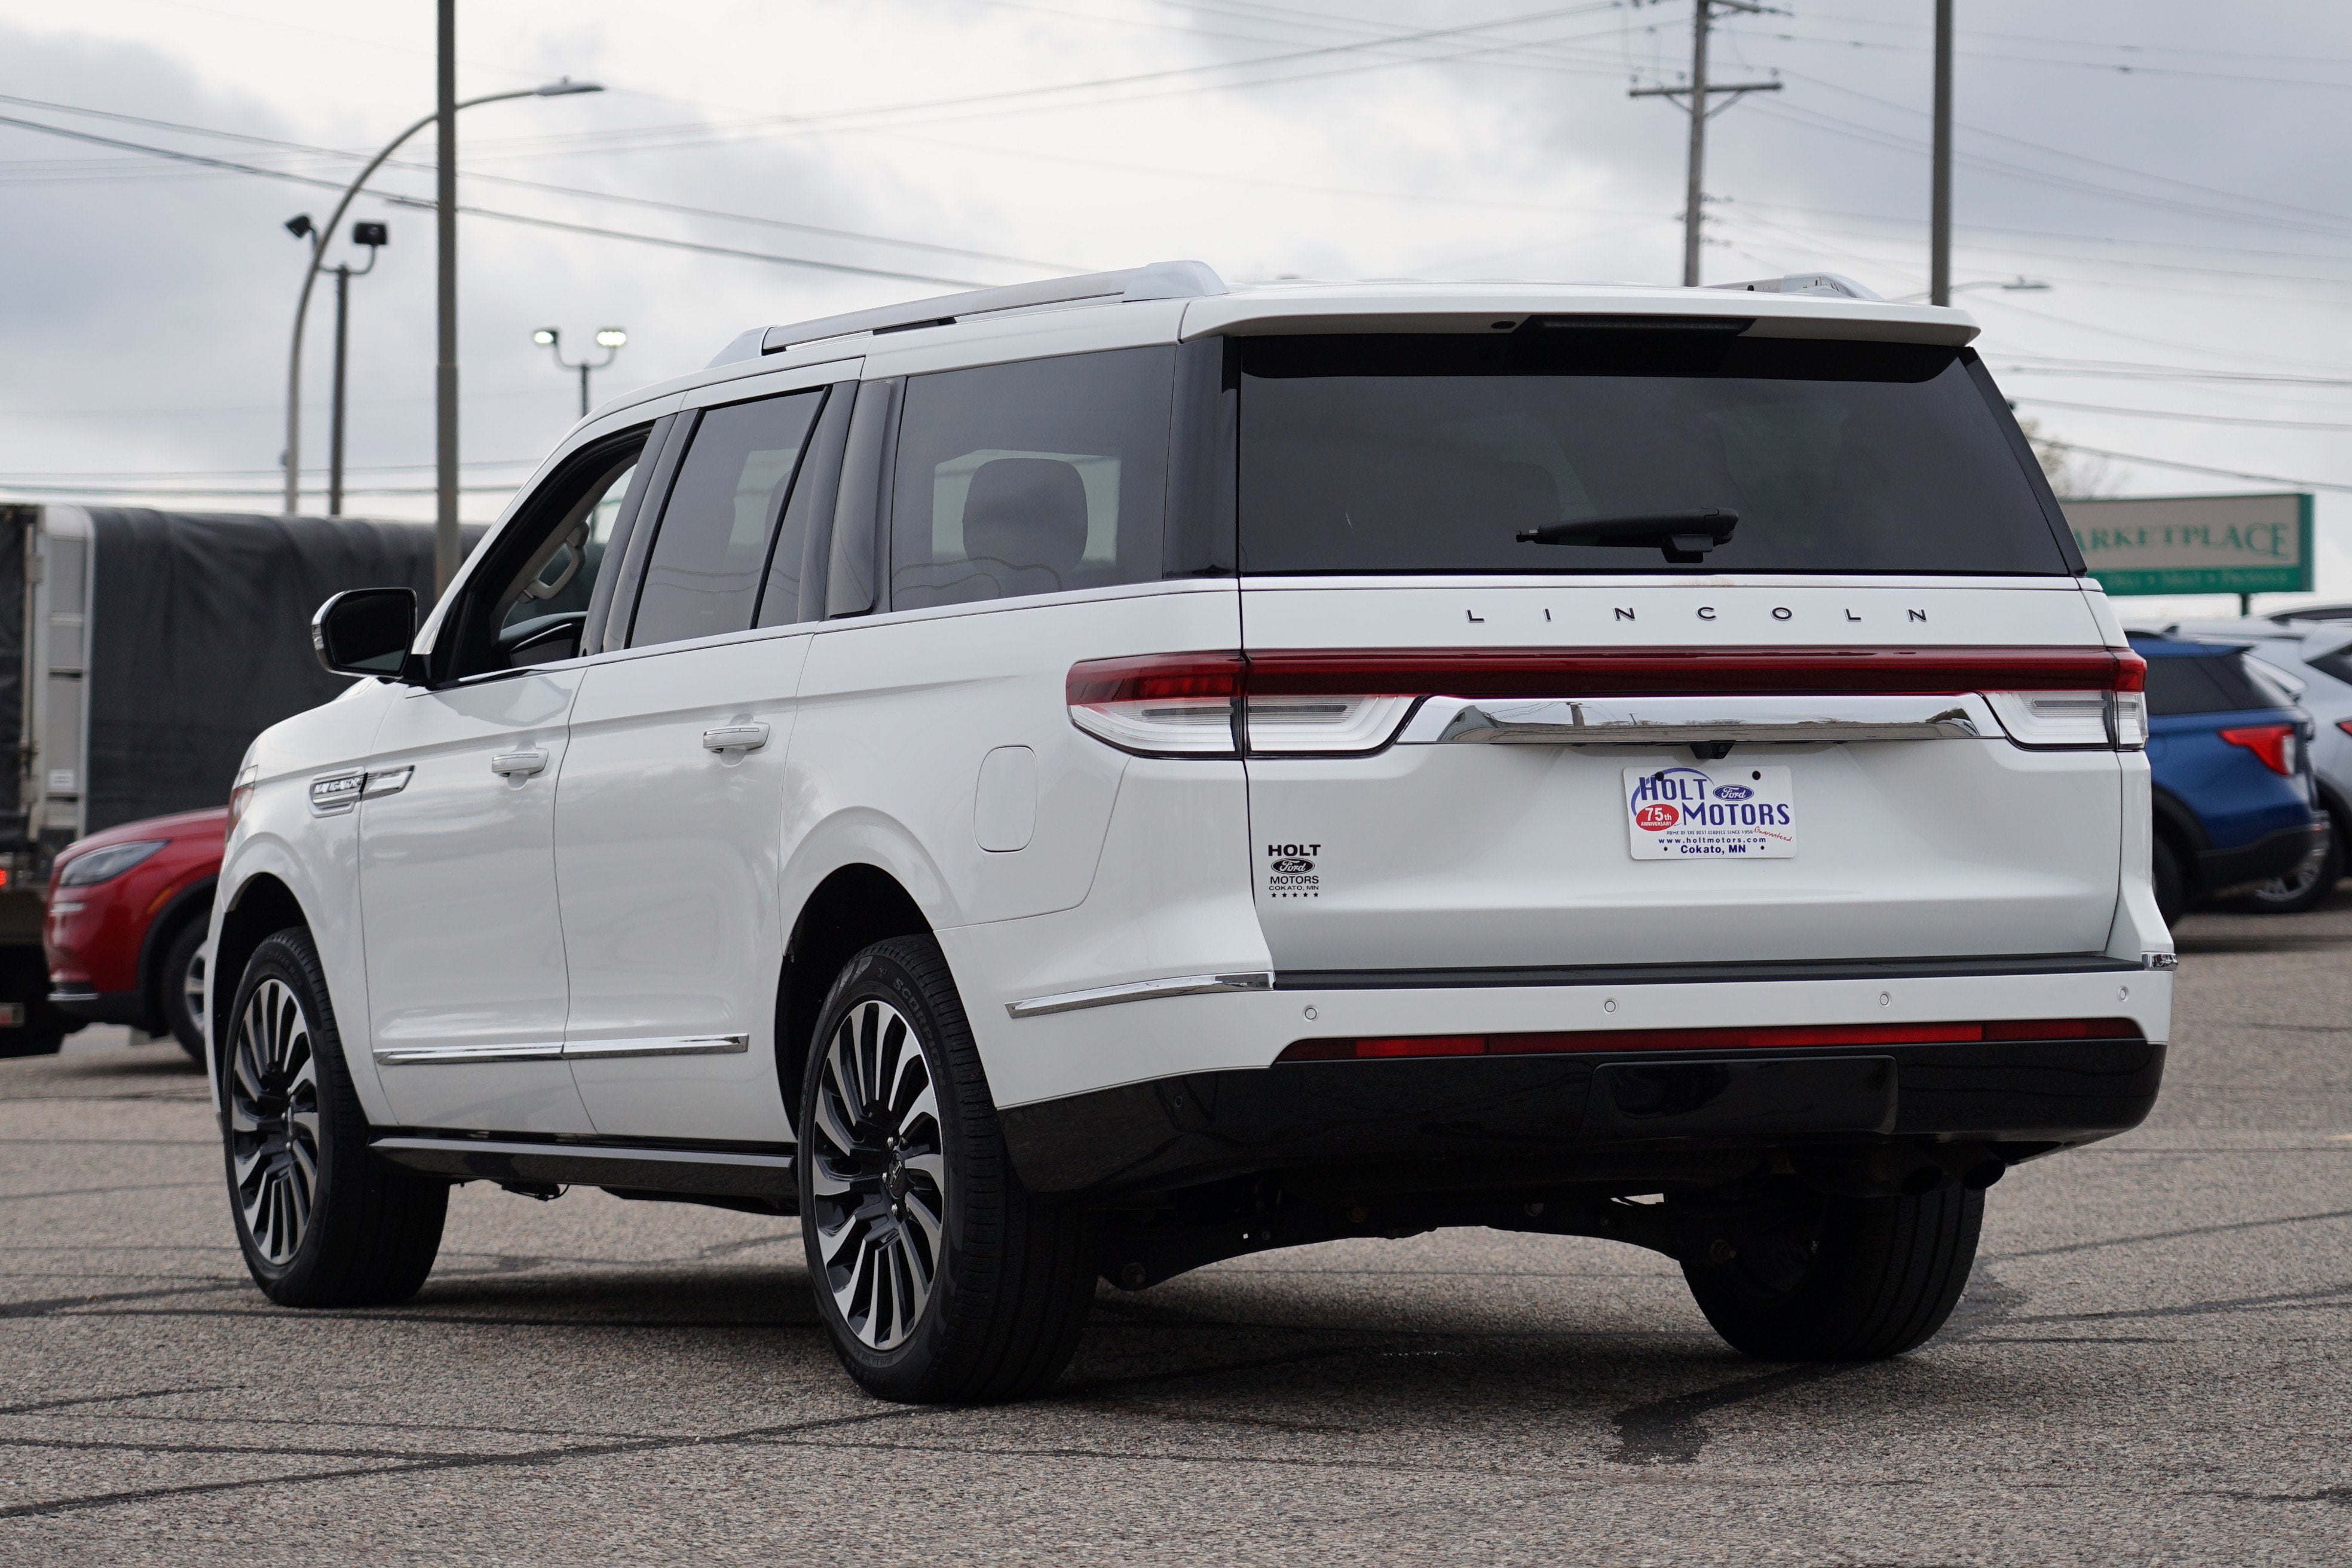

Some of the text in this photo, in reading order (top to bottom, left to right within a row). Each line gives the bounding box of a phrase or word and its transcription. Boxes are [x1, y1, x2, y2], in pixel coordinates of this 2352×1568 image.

[2074, 522, 2289, 559] ARKETPLACE
[1466, 606, 1927, 623] LINCOLN
[1639, 776, 1707, 801] HOLT
[1721, 787, 1746, 798] Ford
[1645, 807, 1672, 821] 75th
[1682, 801, 1790, 826] MOTORS
[1754, 826, 1793, 842] Guaranteed
[1268, 844, 1321, 856] HOLT
[1680, 844, 1746, 855] Cokato, MN
[1279, 860, 1307, 872] Ford
[1270, 875, 1319, 884] MOTORS
